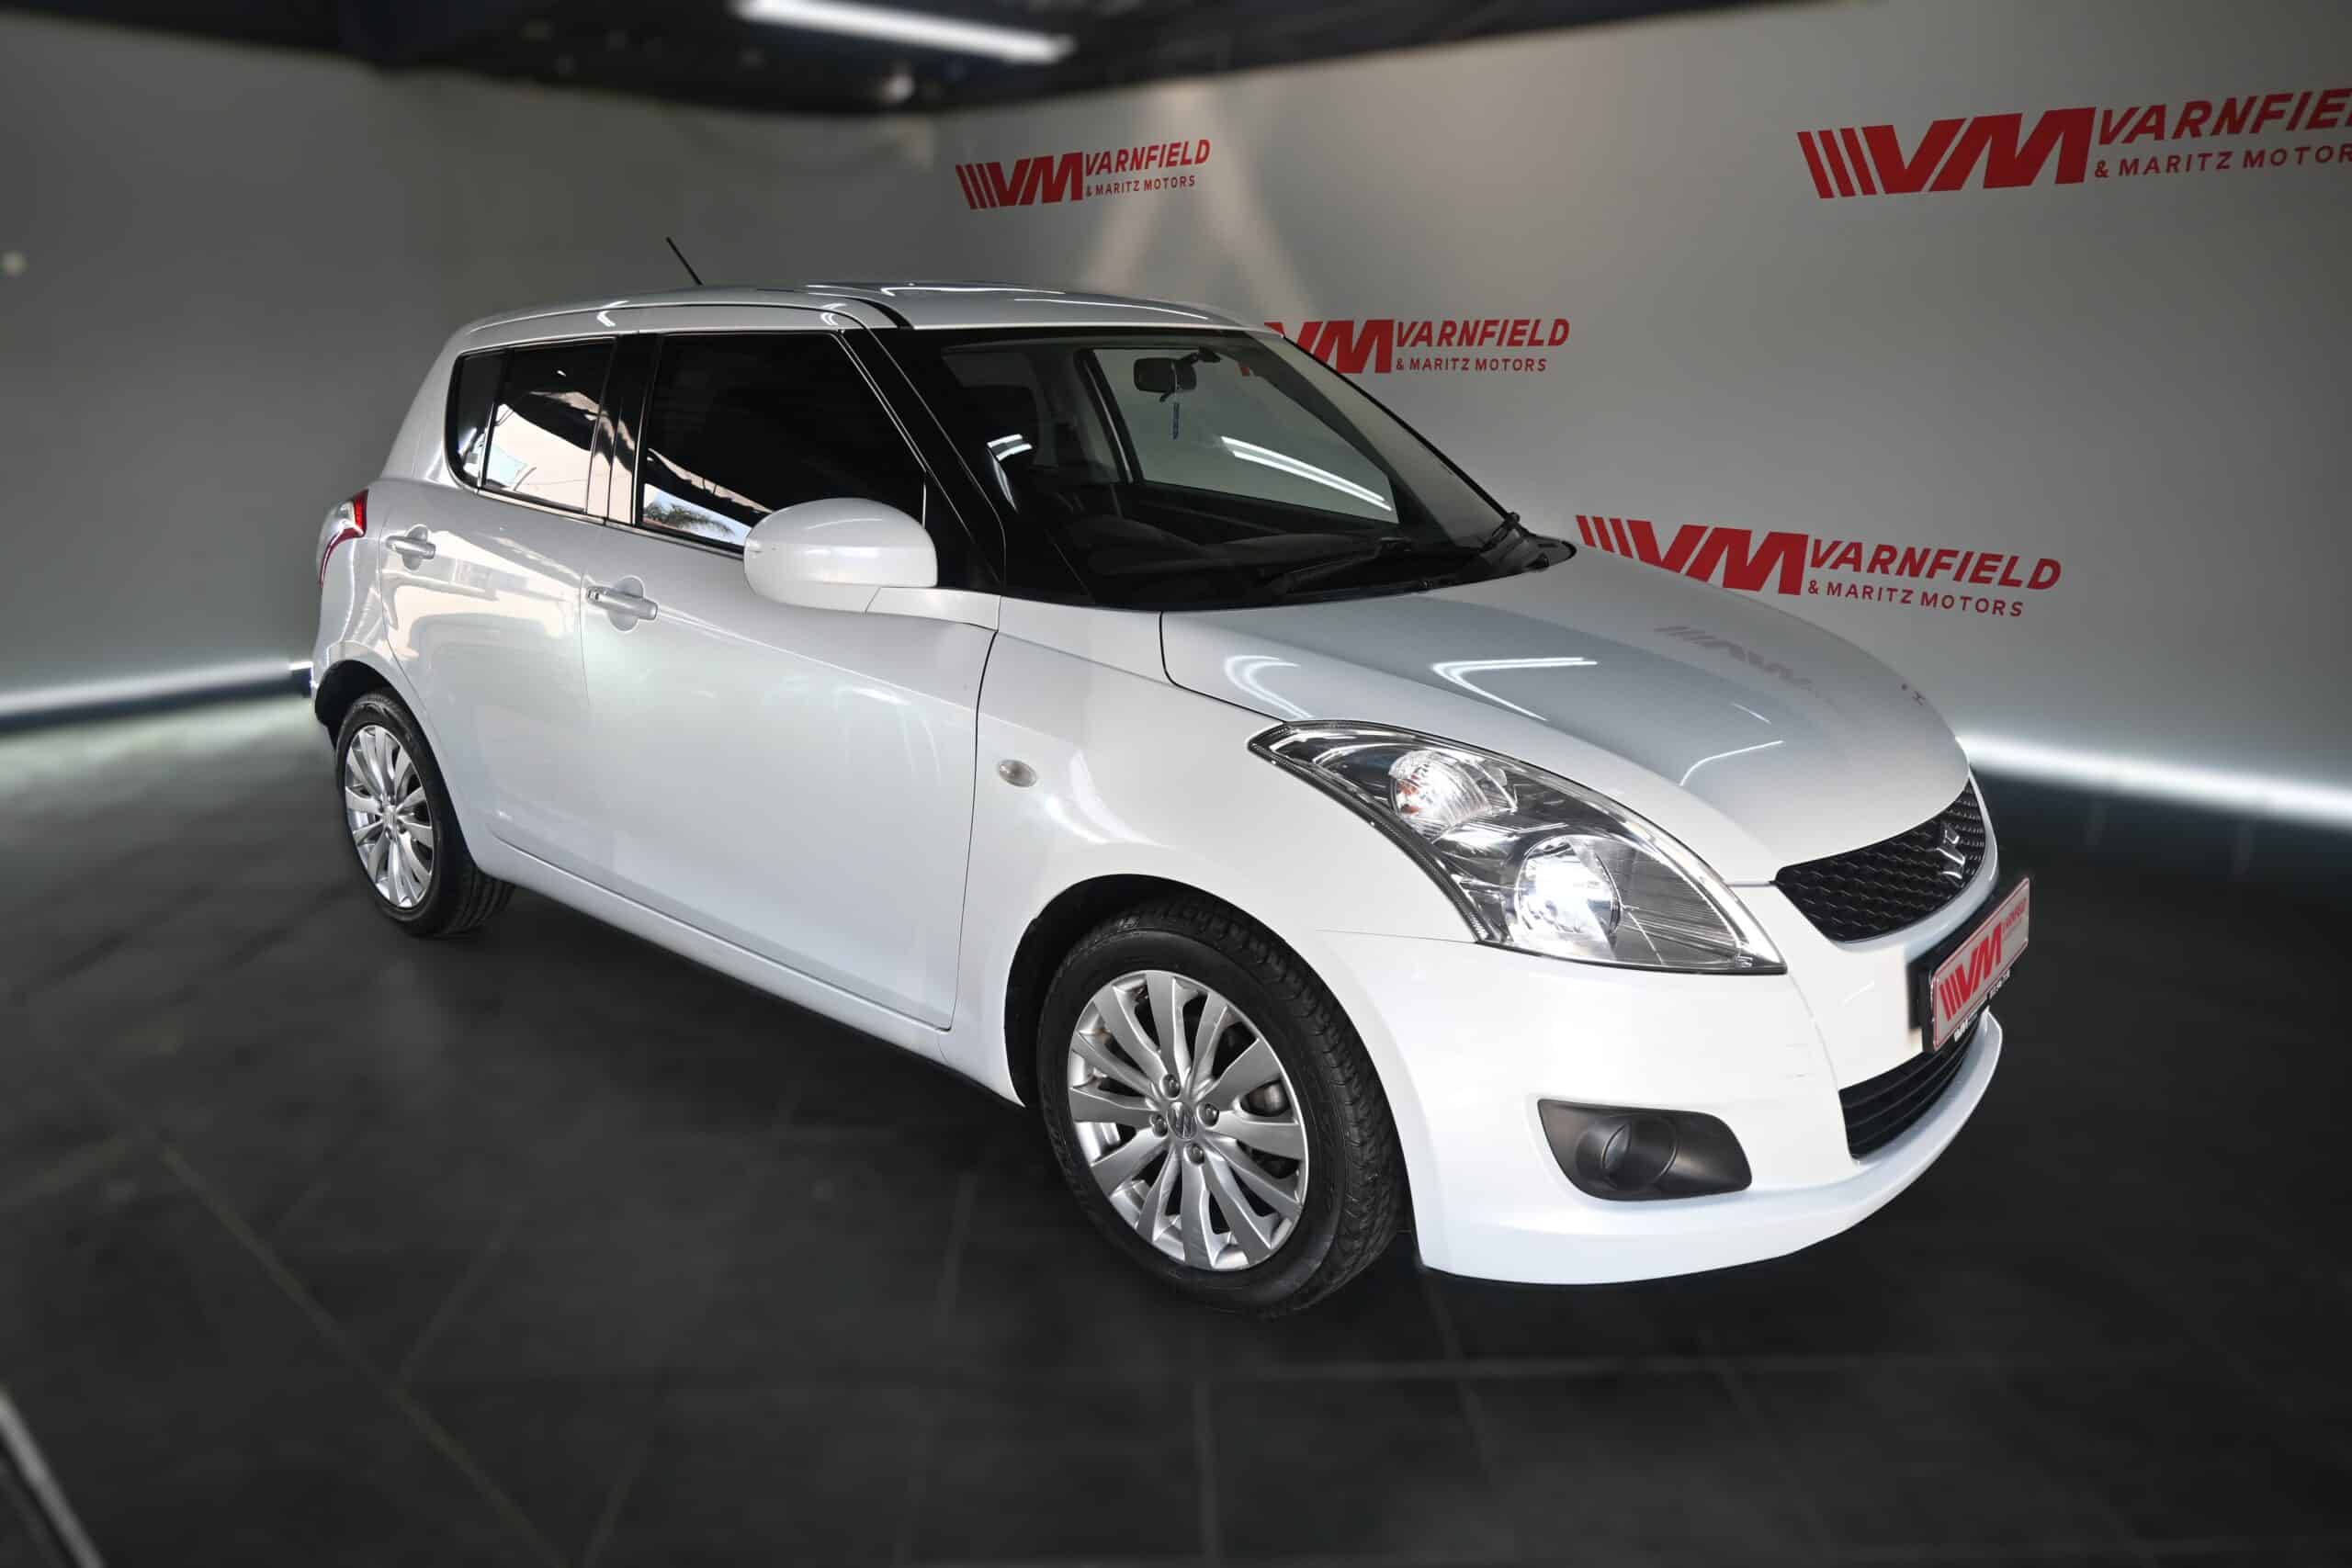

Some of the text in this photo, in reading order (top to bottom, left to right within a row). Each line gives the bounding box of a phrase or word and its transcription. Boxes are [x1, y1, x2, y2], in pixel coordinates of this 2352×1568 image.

[2098, 87, 2352, 146] VARNFIE
[1085, 139, 1212, 176] VARNFIELD
[1861, 106, 2096, 196] VM
[2094, 161, 2109, 178] &
[2118, 151, 2233, 177] MARITZ
[985, 152, 1083, 207] VM
[1085, 175, 1195, 197] & MARITZ MOTORS
[1396, 319, 1570, 349] VARNFIELD
[1396, 357, 1547, 372] & MARITZ MOTORS
[1627, 518, 1809, 596] VM
[1809, 538, 2064, 591] VARNFIELD
[1807, 579, 2024, 618] & MARITZ MOTORS
[1955, 922, 2002, 1003] VM
